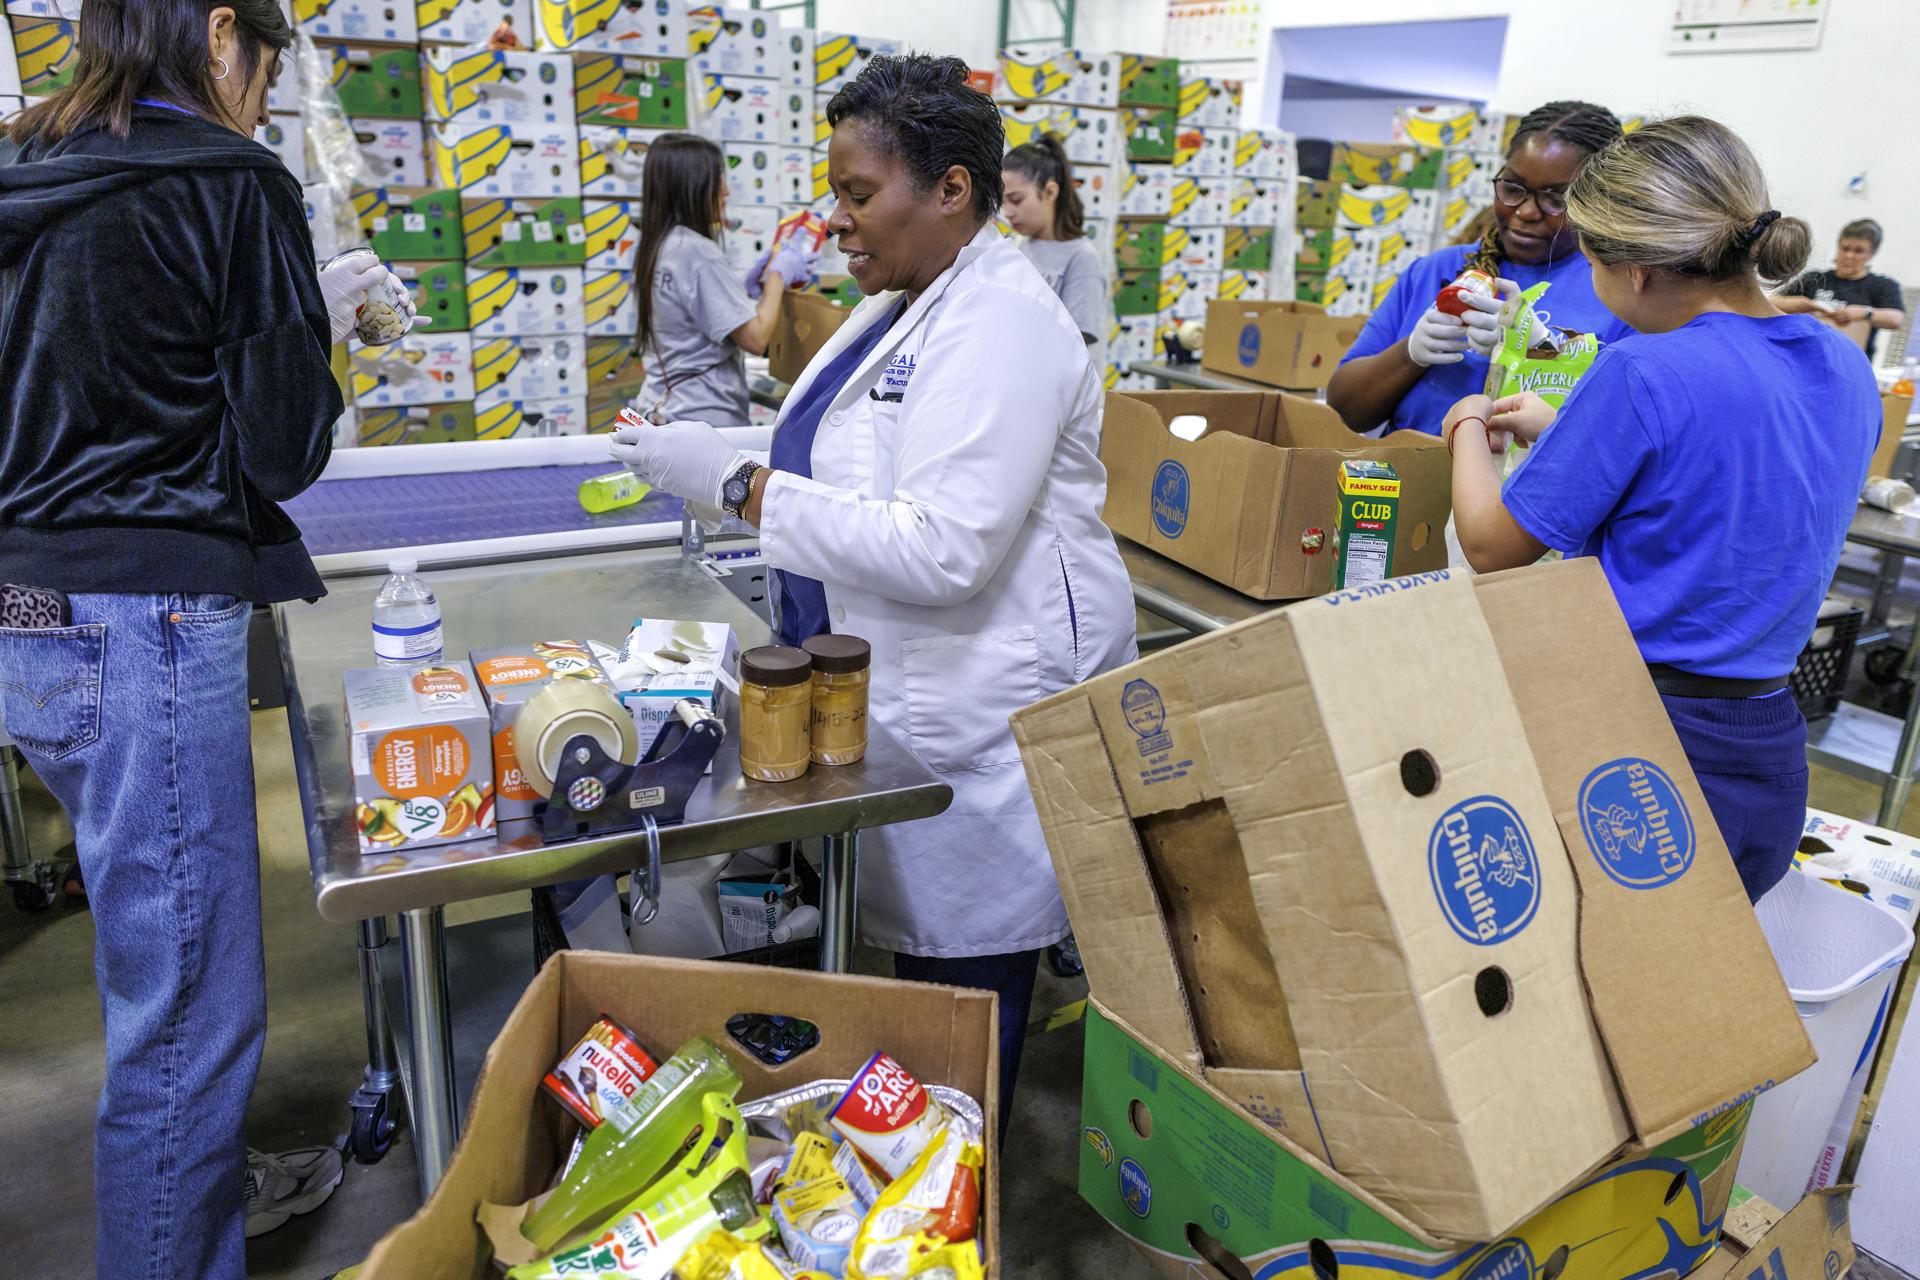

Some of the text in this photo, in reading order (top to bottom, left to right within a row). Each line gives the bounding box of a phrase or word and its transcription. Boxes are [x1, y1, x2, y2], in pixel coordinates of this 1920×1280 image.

[1350, 483, 1378, 491] FAMILY
[1152, 495, 1185, 527] Chiquita
[1351, 501, 1392, 520] CLUB
[490, 668, 541, 683] ENERGY
[386, 743, 396, 787] SPARKLING
[394, 739, 417, 789] ENERGY
[435, 745, 446, 773] Orange
[408, 805, 439, 834] V8
[1627, 762, 1685, 876] Chiquita
[1442, 811, 1499, 942] Chiquita
[582, 1045, 636, 1097] nutella
[857, 1057, 903, 1113] JOAN
[878, 1070, 914, 1114] ARC
[887, 1100, 910, 1126] Butter
[1823, 1146, 1836, 1170] EXTRA
